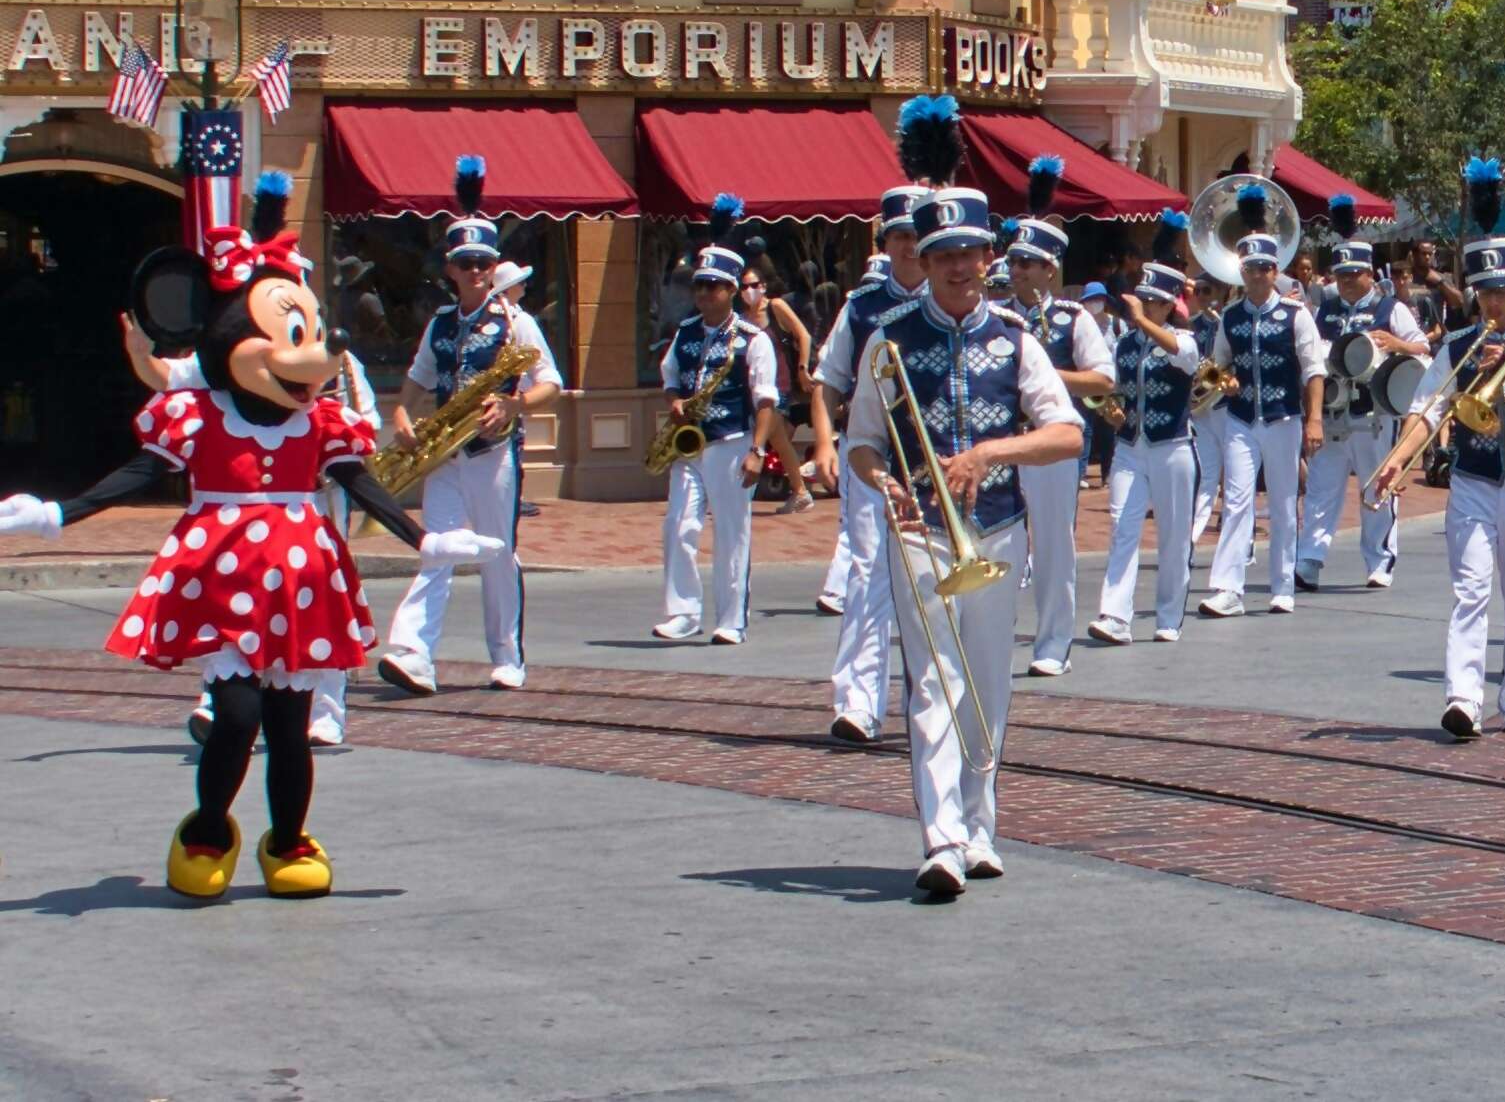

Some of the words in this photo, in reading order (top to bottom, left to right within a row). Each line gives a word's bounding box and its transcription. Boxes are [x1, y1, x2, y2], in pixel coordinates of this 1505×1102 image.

[421, 16, 895, 79] EMPORIUM
[955, 26, 1048, 91] BOOKS
[937, 200, 966, 227] D
[1481, 249, 1502, 270] D
